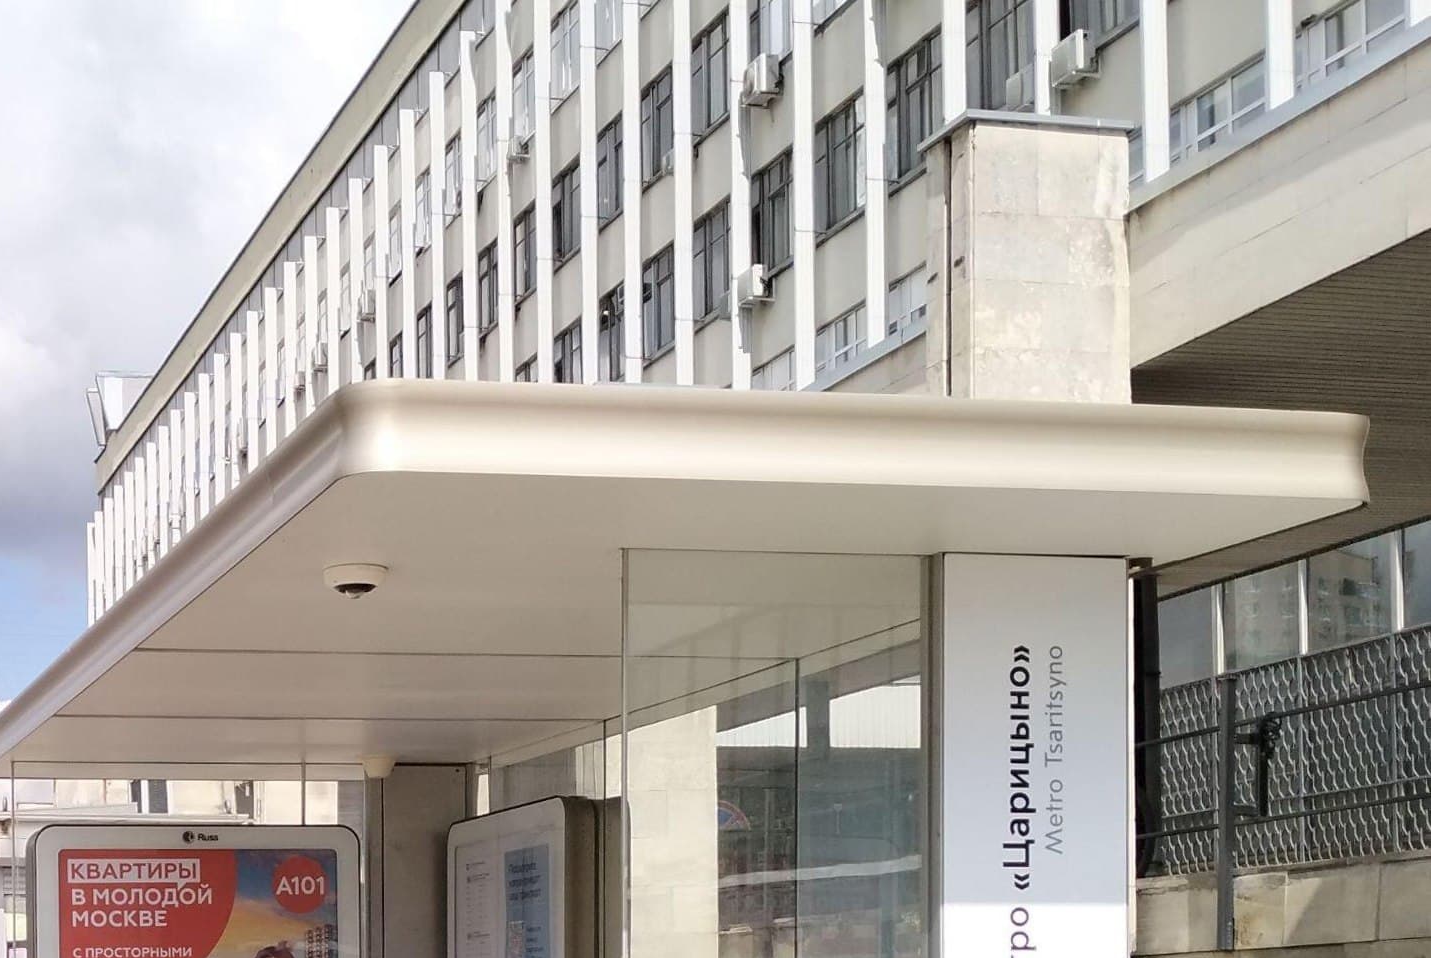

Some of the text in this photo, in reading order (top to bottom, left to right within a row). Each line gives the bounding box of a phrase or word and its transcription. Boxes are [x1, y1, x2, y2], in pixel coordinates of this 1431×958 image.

[1044, 644, 1070, 855] Metro Tsaritsyno
[1002, 644, 1038, 891] «Царицыно»
[71, 862, 197, 880] КВАРТИРЫ
[71, 883, 213, 908] В МОЛОДОЙ
[72, 909, 168, 928] МОСКВЕ
[73, 946, 193, 958] С ПРОСТОРНЫМИ
